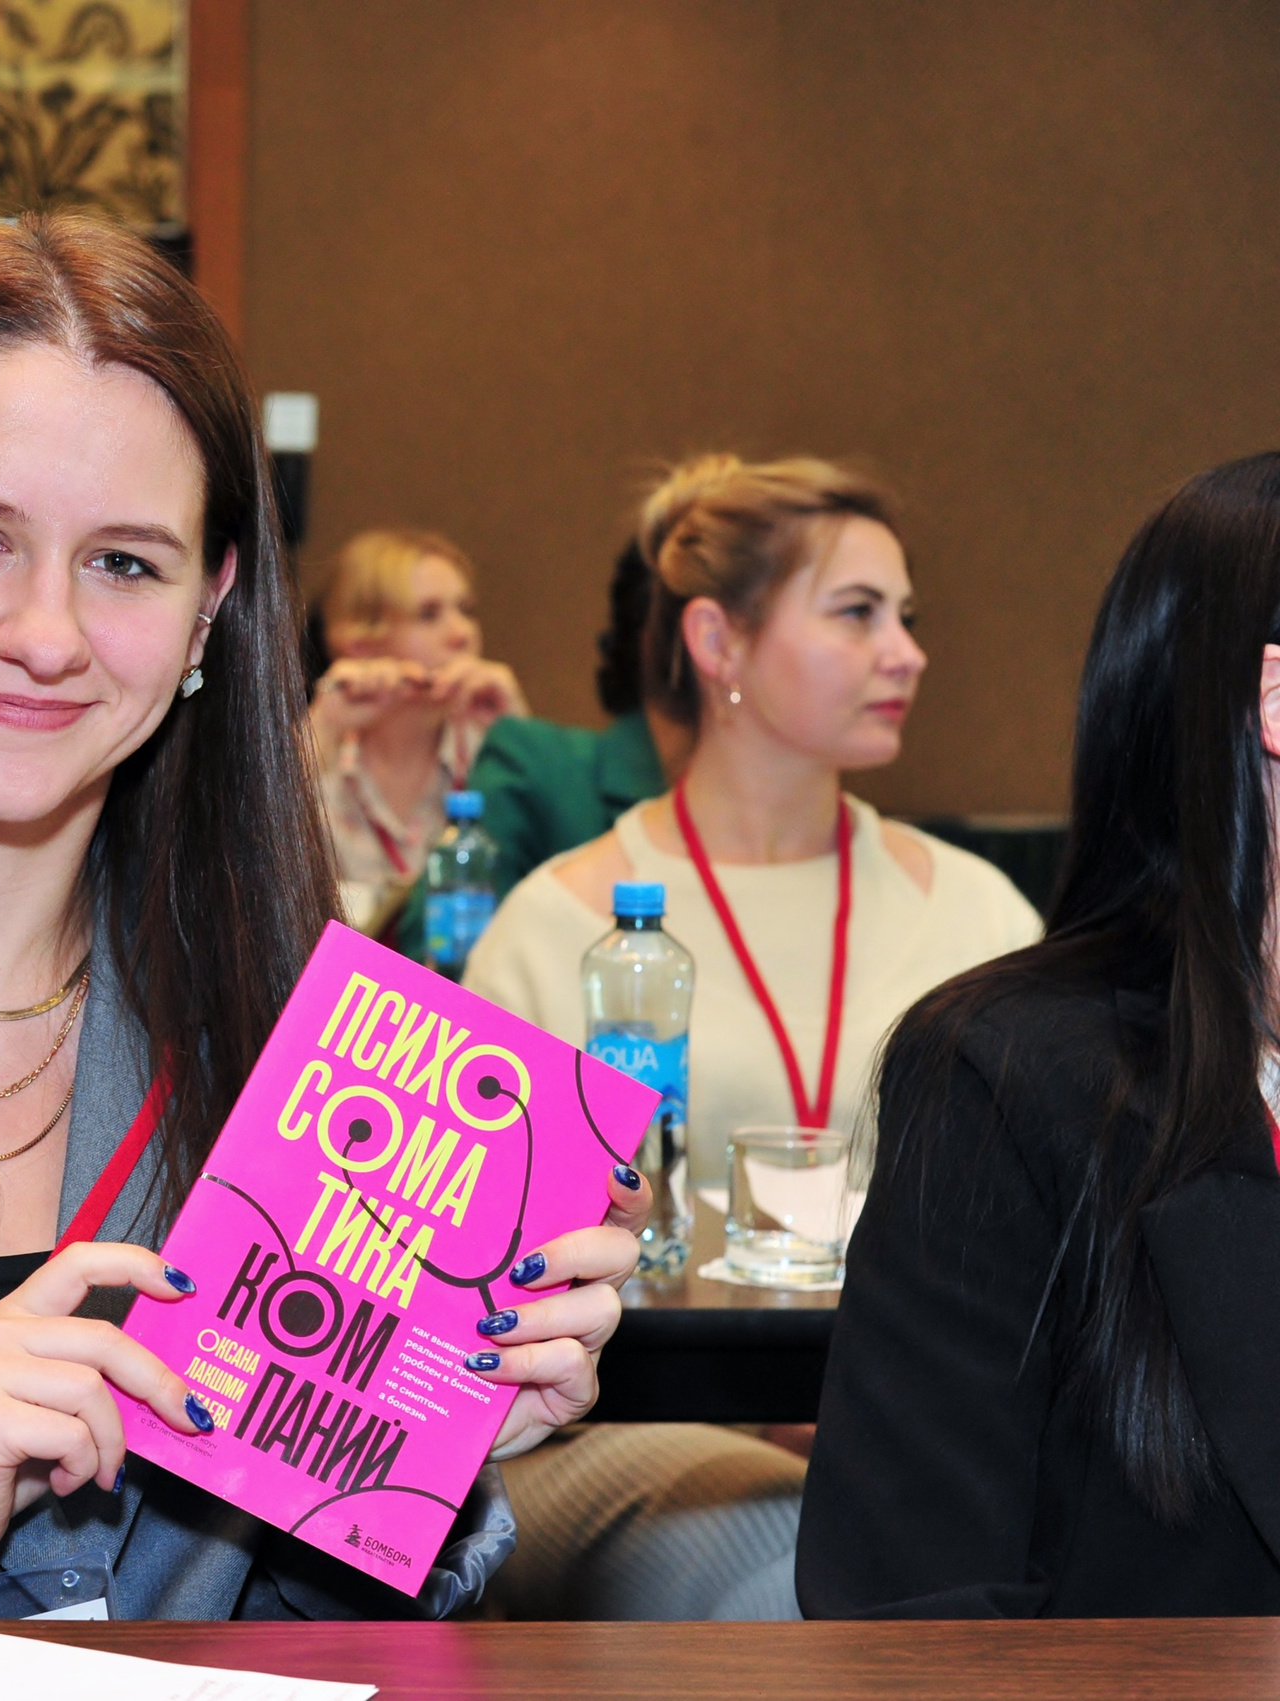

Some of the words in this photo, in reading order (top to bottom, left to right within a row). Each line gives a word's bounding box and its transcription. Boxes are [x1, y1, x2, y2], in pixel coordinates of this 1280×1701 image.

[318, 972, 532, 1131] ПСИХО
[278, 1060, 488, 1227] СОМА
[294, 1172, 435, 1309] ТИКА
[216, 1242, 400, 1393] КОМ
[411, 1326, 431, 1339] как
[196, 1328, 261, 1376] ОКСАНА
[404, 1338, 454, 1369] реальные
[454, 1364, 498, 1392] причины
[184, 1356, 248, 1403] ЛАКШМИ
[384, 1379, 399, 1390] не
[392, 1366, 400, 1374] и
[400, 1371, 434, 1392] лечить
[398, 1352, 442, 1379] проблем
[442, 1375, 449, 1383] в
[450, 1378, 491, 1405] бизнесе
[234, 1362, 408, 1492] ПАНИЙ
[378, 1392, 386, 1400] а
[387, 1395, 427, 1422] болезнь
[364, 1536, 412, 1569] БОМБОРА
